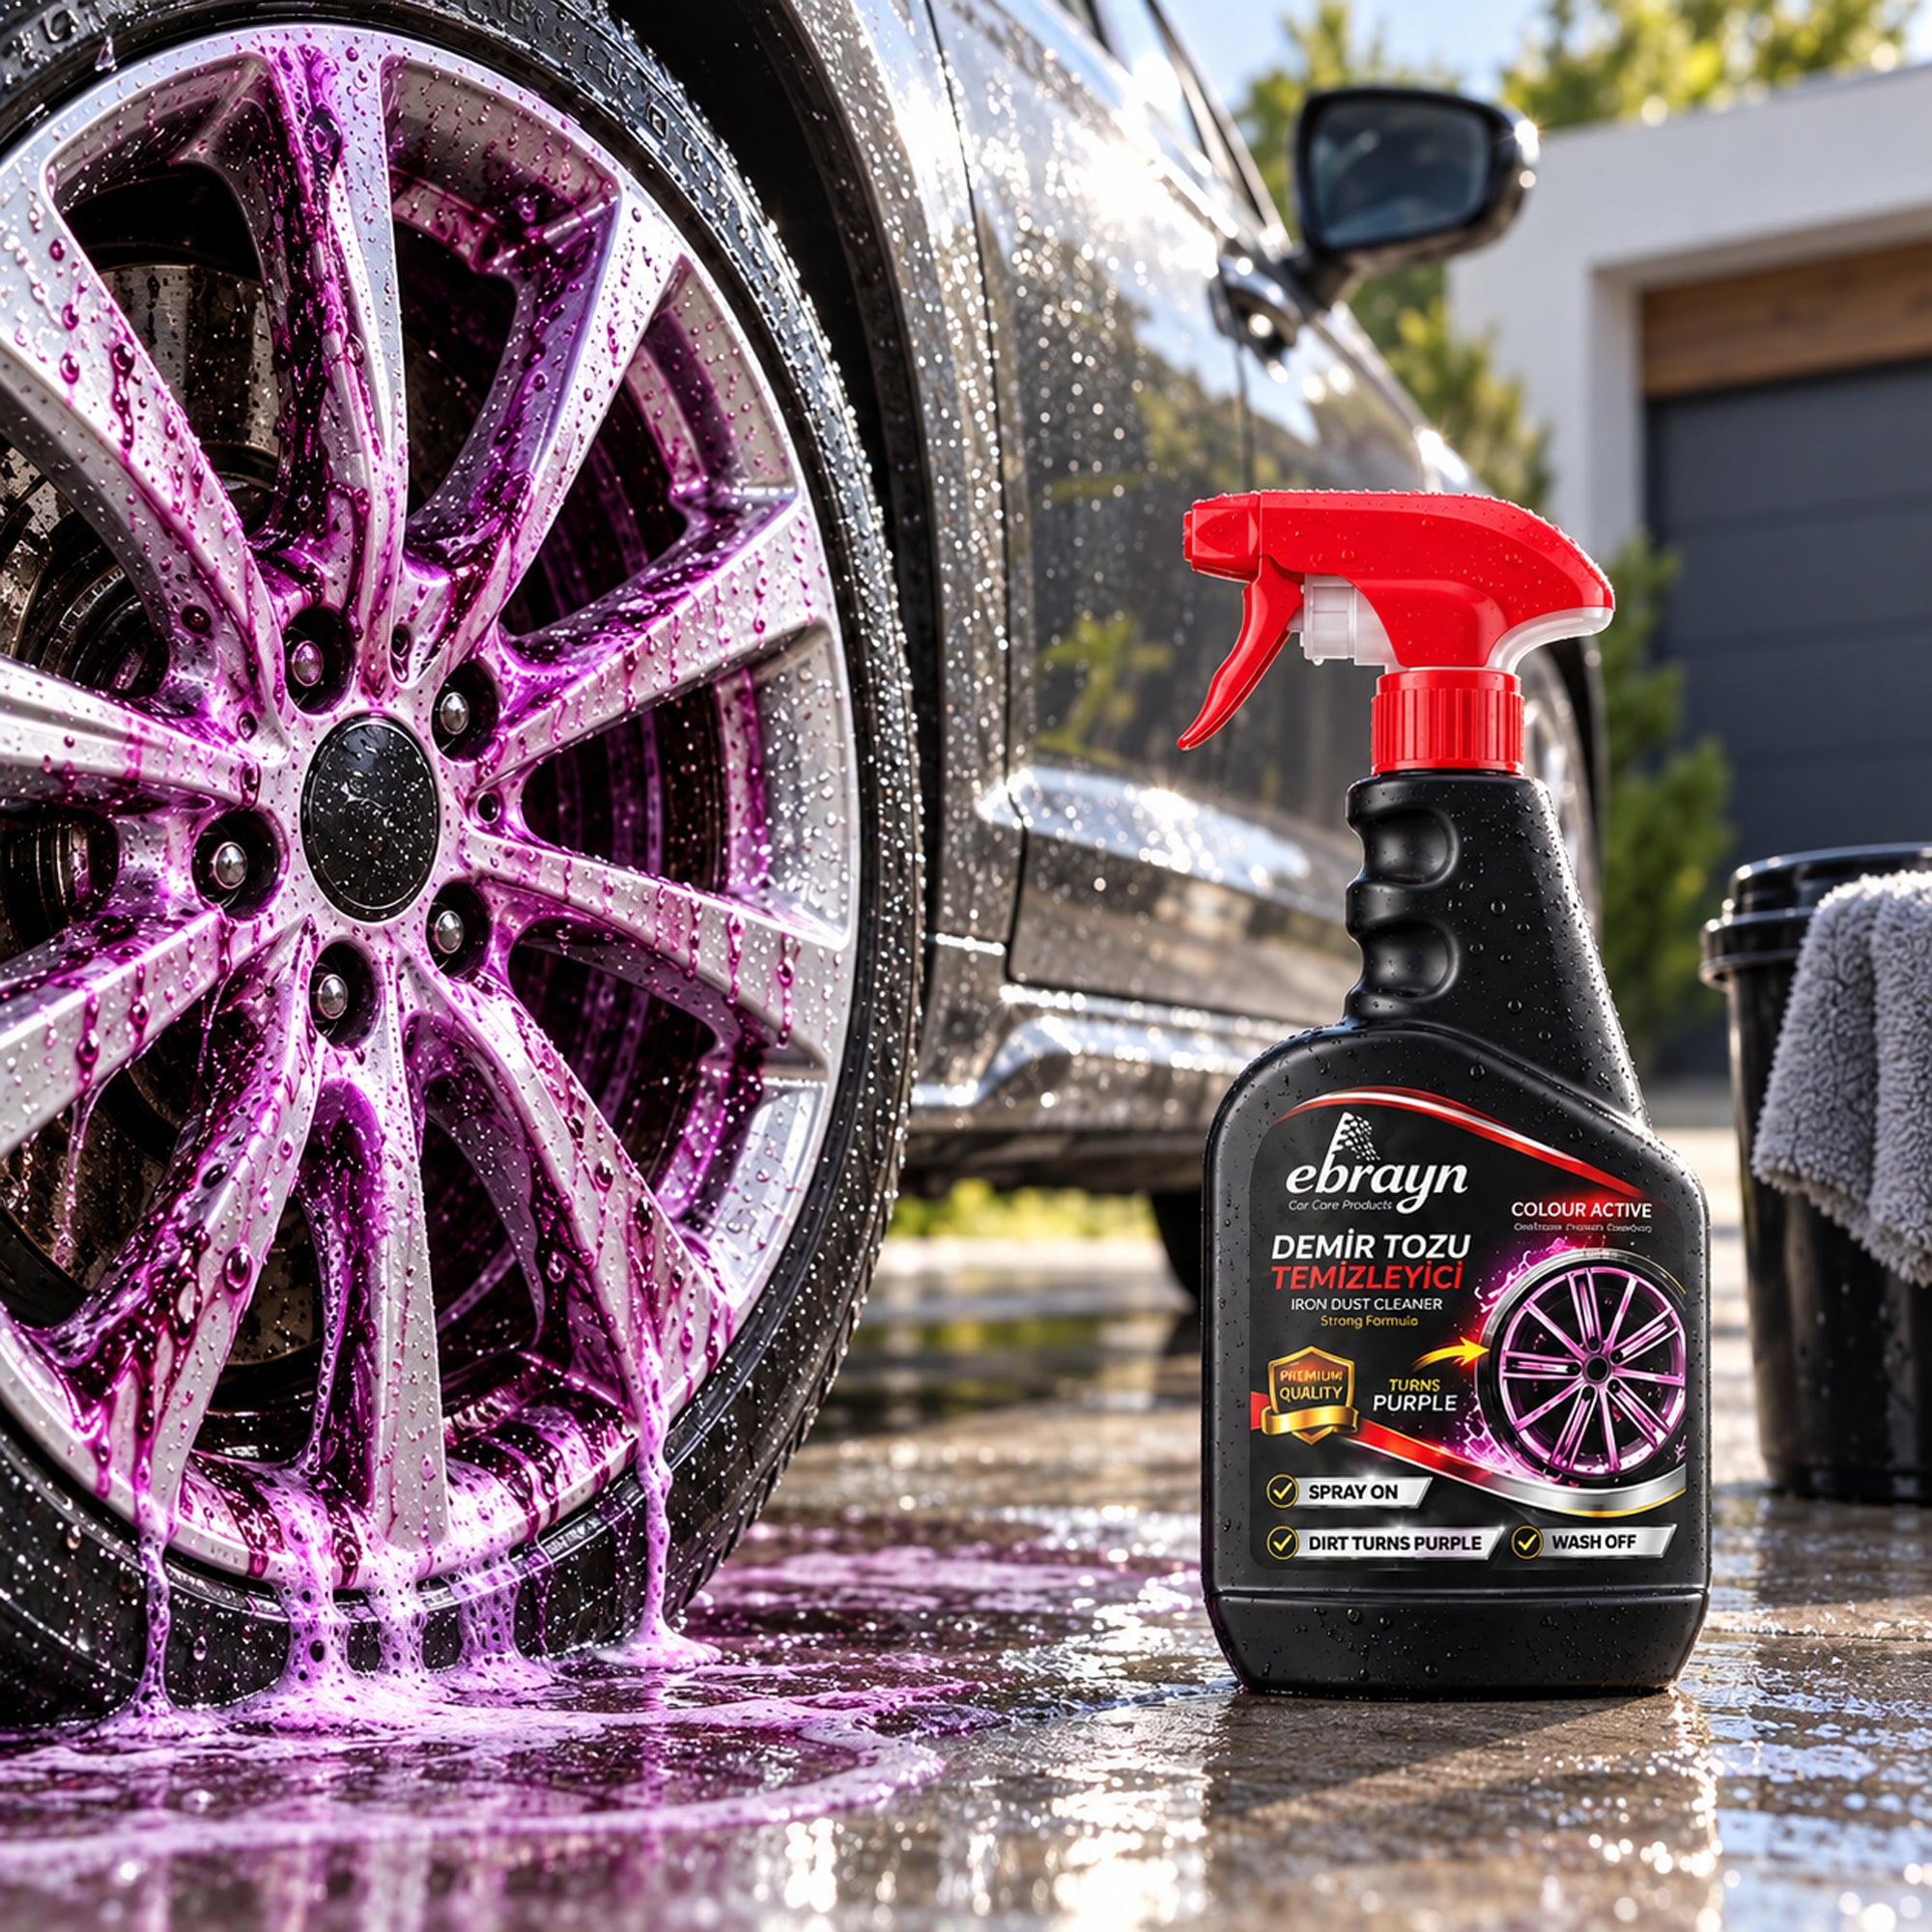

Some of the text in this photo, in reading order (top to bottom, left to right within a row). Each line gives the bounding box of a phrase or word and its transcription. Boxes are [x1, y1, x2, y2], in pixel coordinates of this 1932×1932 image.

[1286, 1113, 1468, 1214] ebrayn
[1342, 1199, 1392, 1210] Products
[1511, 1202, 1653, 1218] COLOUR ACTIVE
[1271, 1228, 1471, 1260] DEMİR TOZU
[1271, 1260, 1463, 1290] TEMİZLEYİCİ
[1291, 1298, 1443, 1310] IRON DUST CLEANER
[1321, 1315, 1363, 1329] Strong
[1279, 1369, 1344, 1382] PREMIUM
[1389, 1378, 1441, 1392] TURNS
[1279, 1385, 1343, 1402] QUALITY
[1373, 1394, 1458, 1411] PURPLE
[1309, 1485, 1398, 1499] SPRAY ON
[1309, 1536, 1482, 1550] DIRT TURNS PURPLE
[1551, 1534, 1636, 1549] WASH OFF
